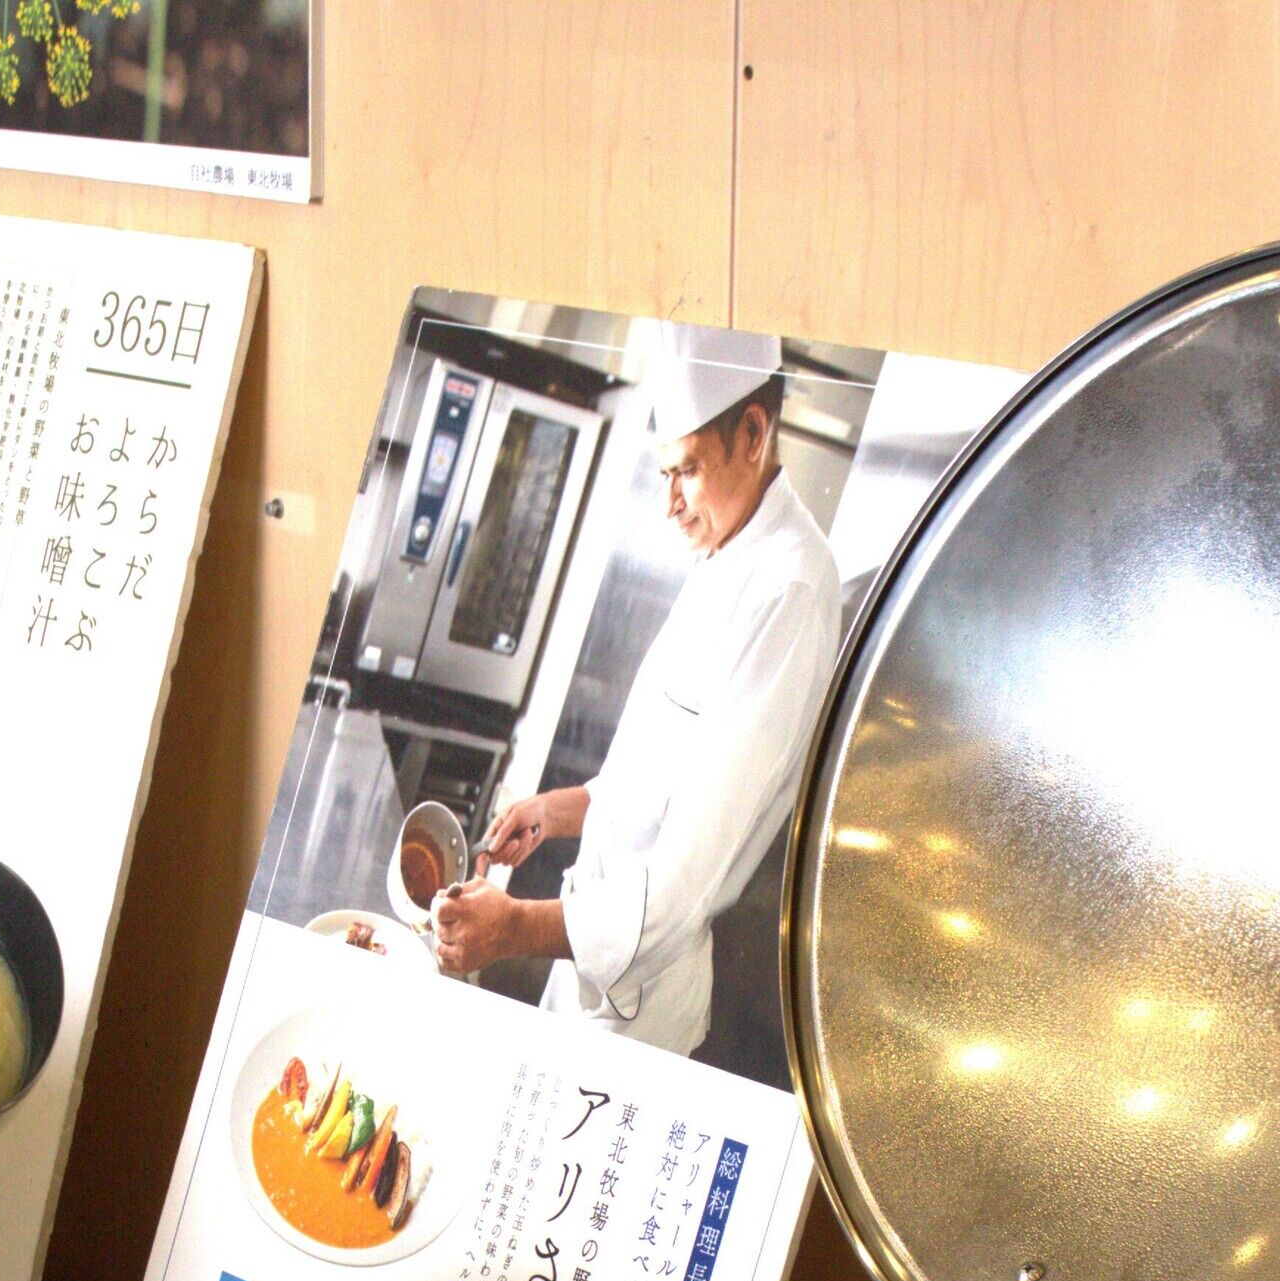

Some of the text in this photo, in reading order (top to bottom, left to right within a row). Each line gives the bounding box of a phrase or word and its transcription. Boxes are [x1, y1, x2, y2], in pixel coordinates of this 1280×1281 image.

[15, 306, 71, 526] 東北牧場の野菜と野草
[93, 290, 210, 365] 365日
[26, 412, 100, 648] お味噌汁
[65, 416, 132, 654] よろこぶ
[118, 424, 179, 602] からだ
